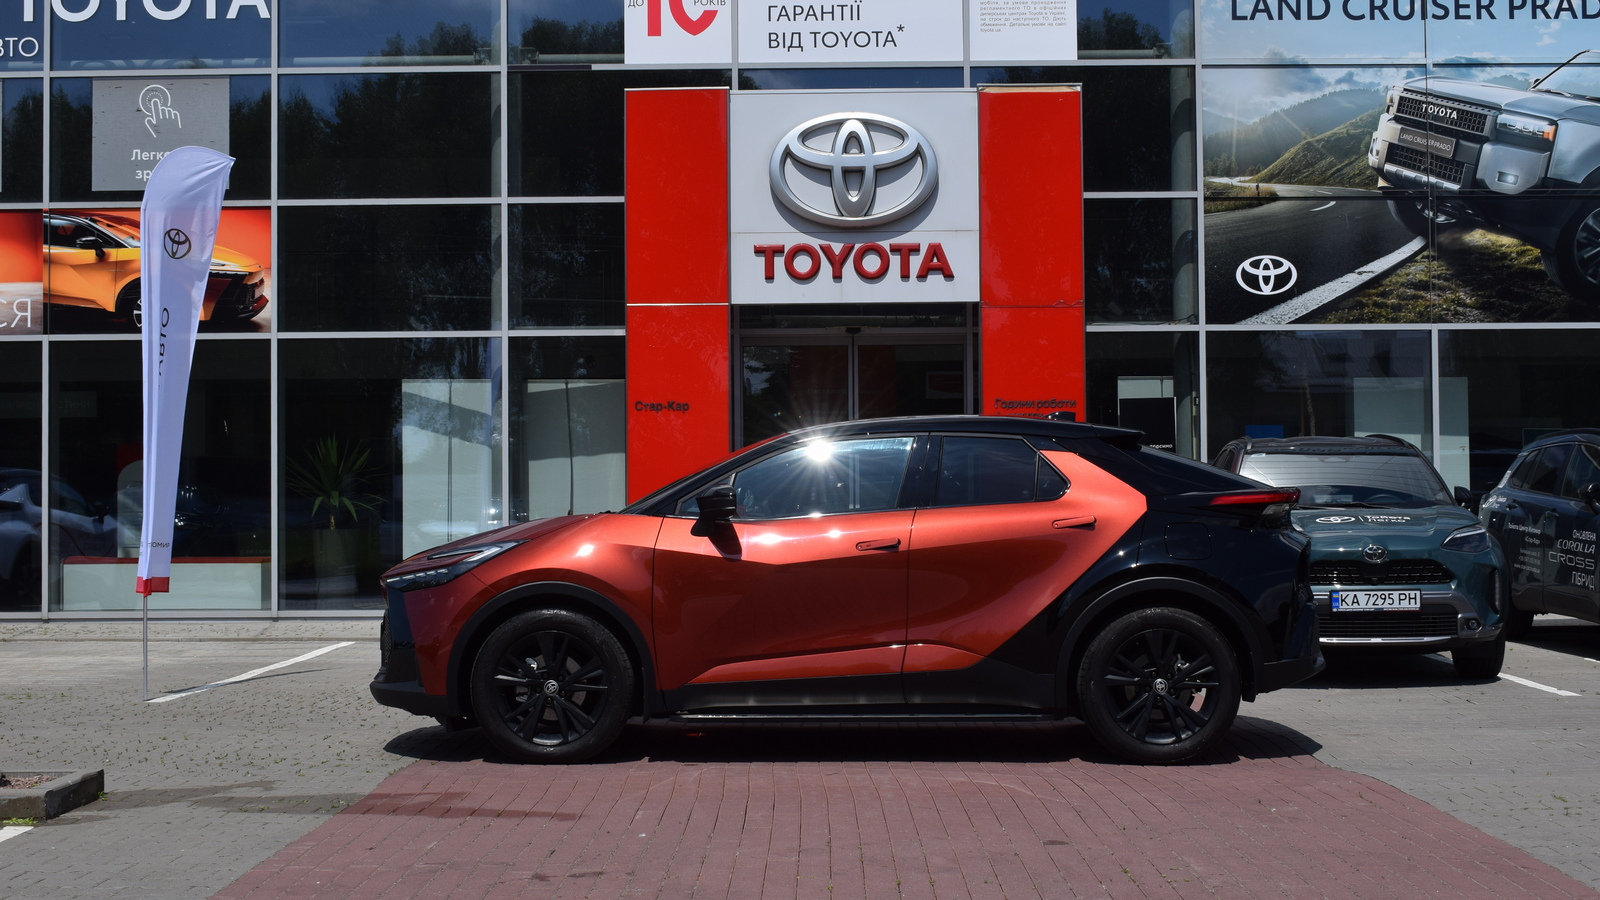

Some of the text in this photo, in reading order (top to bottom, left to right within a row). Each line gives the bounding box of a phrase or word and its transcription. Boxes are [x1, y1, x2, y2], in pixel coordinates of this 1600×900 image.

[23, 0, 271, 22] OOA
[768, 0, 862, 21] ГАРАНТІЇ
[1231, 0, 1331, 21] LAND
[1342, 0, 1497, 21] CRUISER
[768, 32, 804, 52] ВІД
[1422, 104, 1458, 120] TOYOTA
[1400, 133, 1414, 141] LAND
[131, 149, 169, 160] Легк
[754, 242, 955, 280] TOYOTA
[634, 401, 690, 413] Стар-Кар
[994, 398, 1076, 410] Години роботи
[1556, 539, 1596, 554] COROLLA
[1548, 551, 1595, 570] CROSS
[1340, 594, 1360, 606] KA
[1364, 593, 1394, 606] 7295
[1398, 592, 1417, 606] PH
